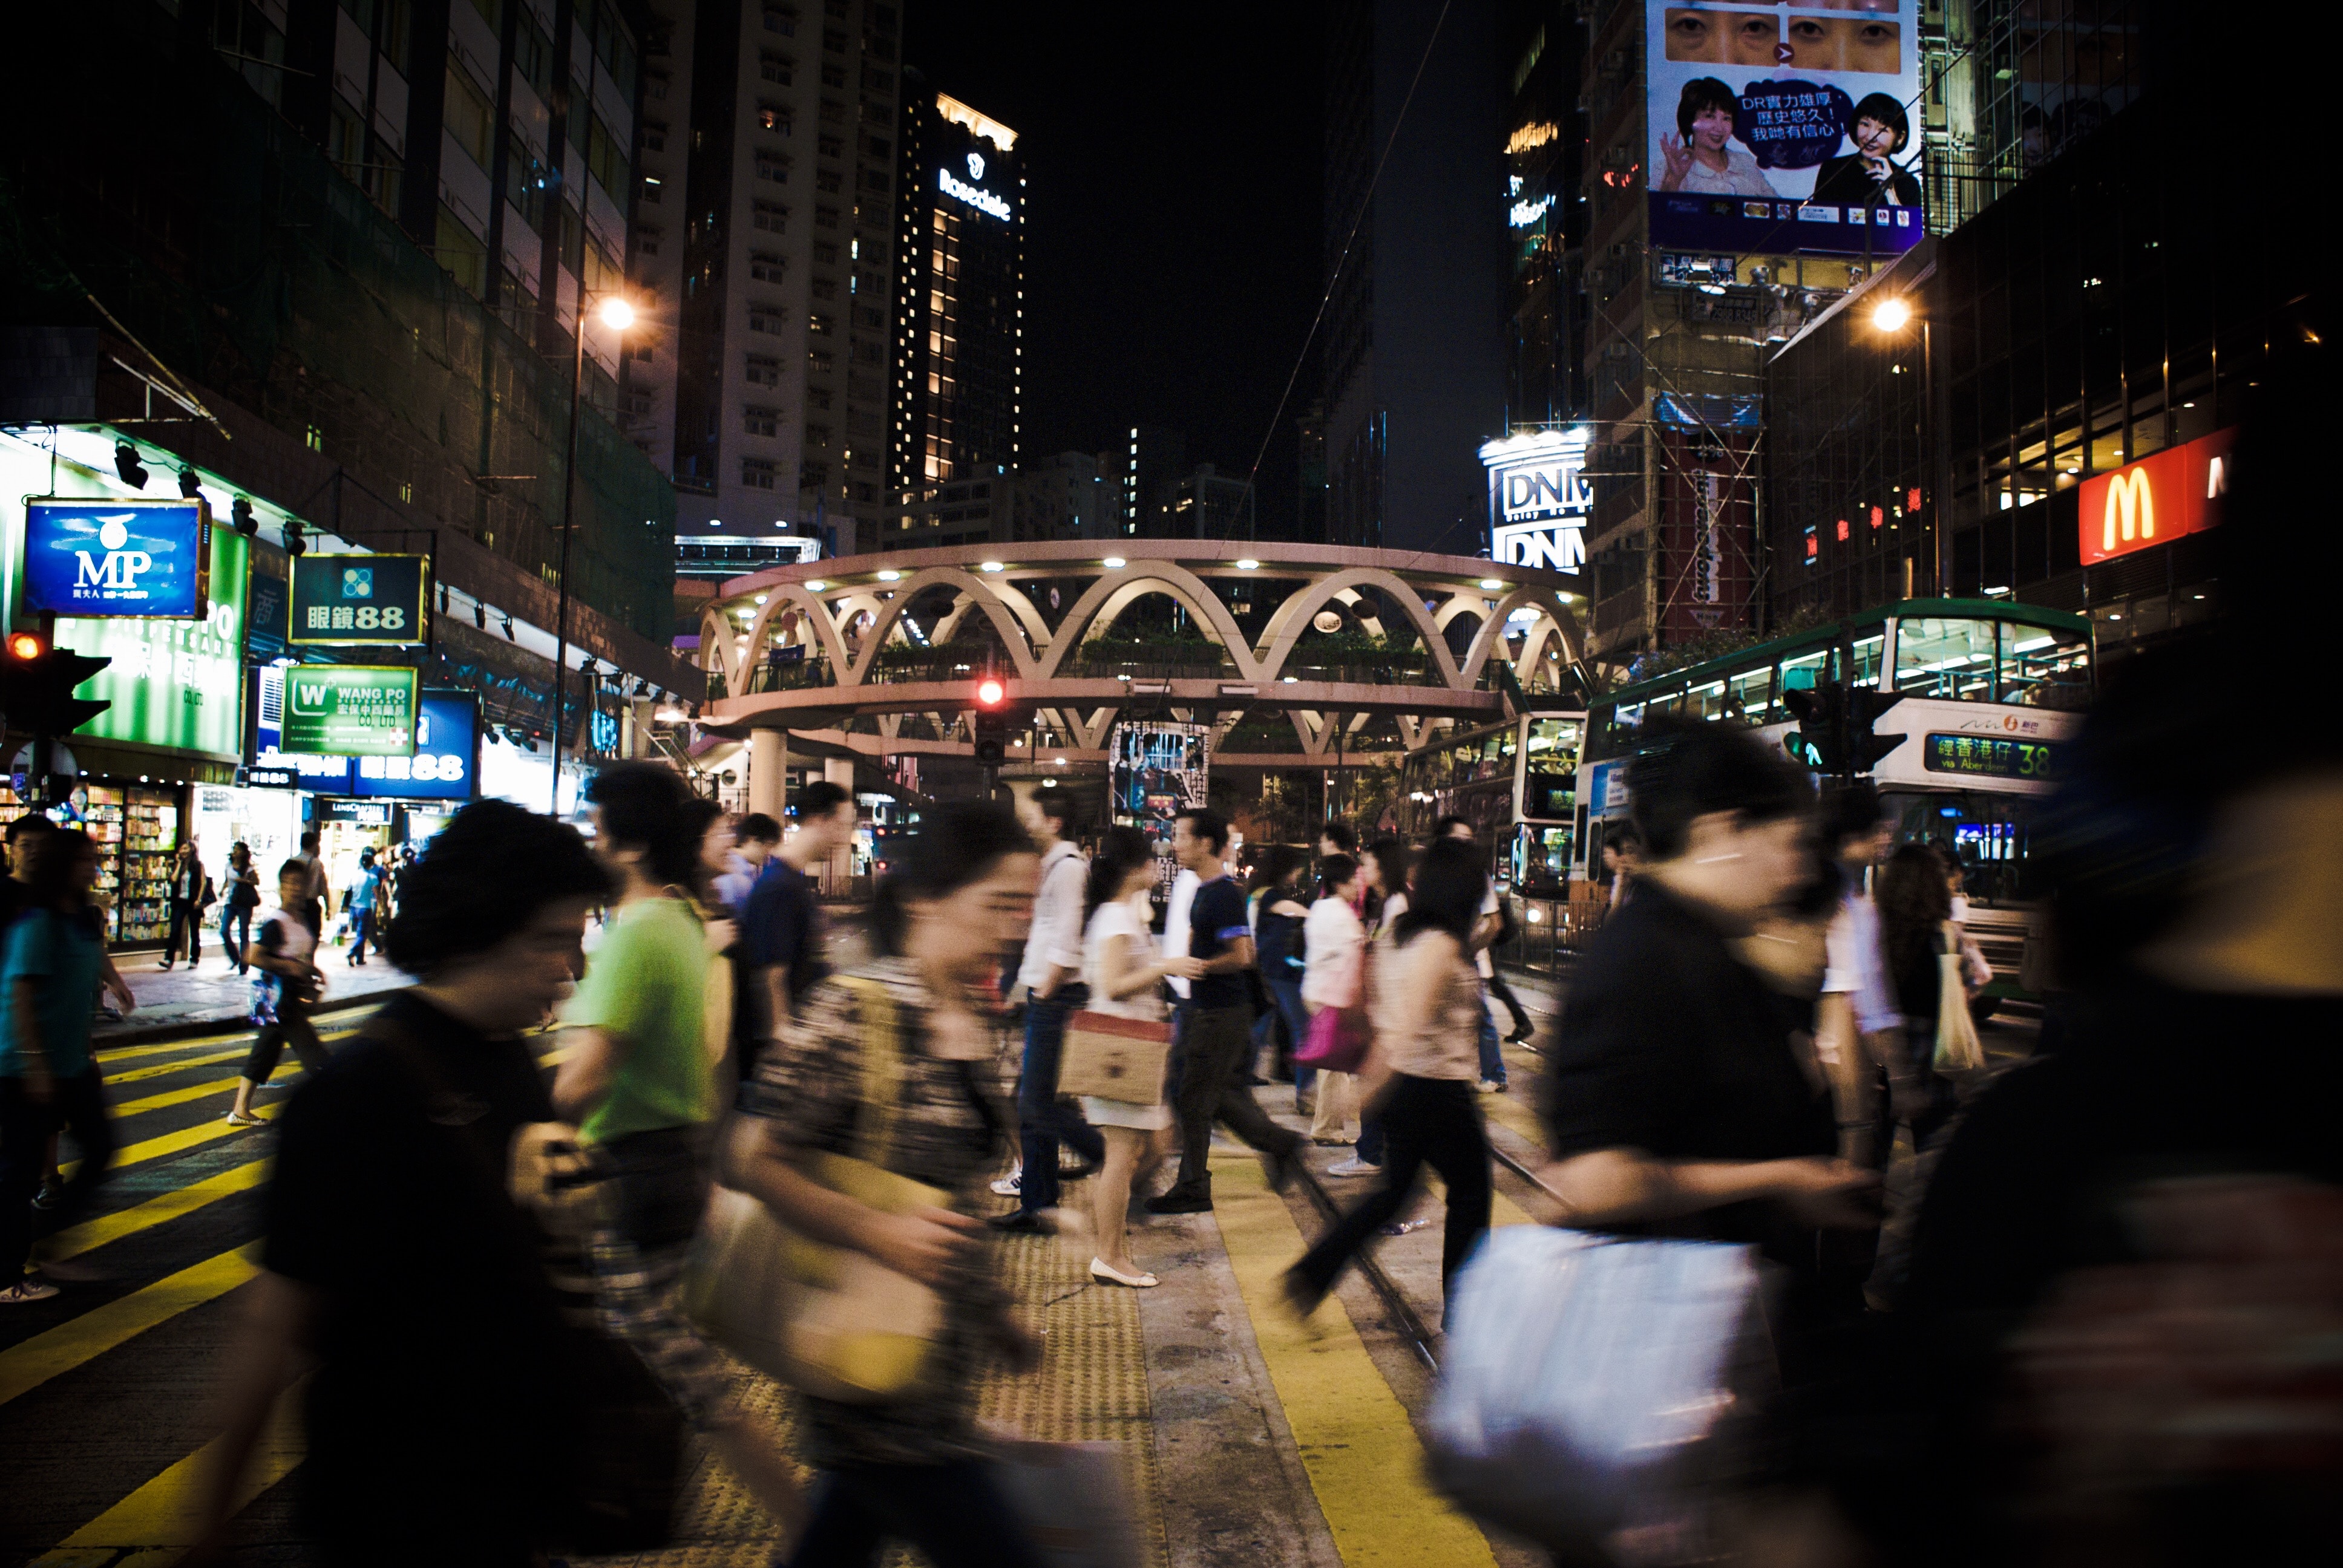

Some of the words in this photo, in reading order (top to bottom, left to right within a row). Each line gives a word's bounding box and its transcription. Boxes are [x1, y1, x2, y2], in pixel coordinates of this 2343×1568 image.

[939, 168, 1011, 222] Rosedale
[73, 550, 152, 589] MP
[307, 606, 405, 630] 眼鏡88
[300, 684, 328, 706] W
[338, 687, 382, 699] WANG
[385, 688, 406, 700] PO
[1942, 760, 1956, 769] via
[2018, 744, 2050, 776] 38
